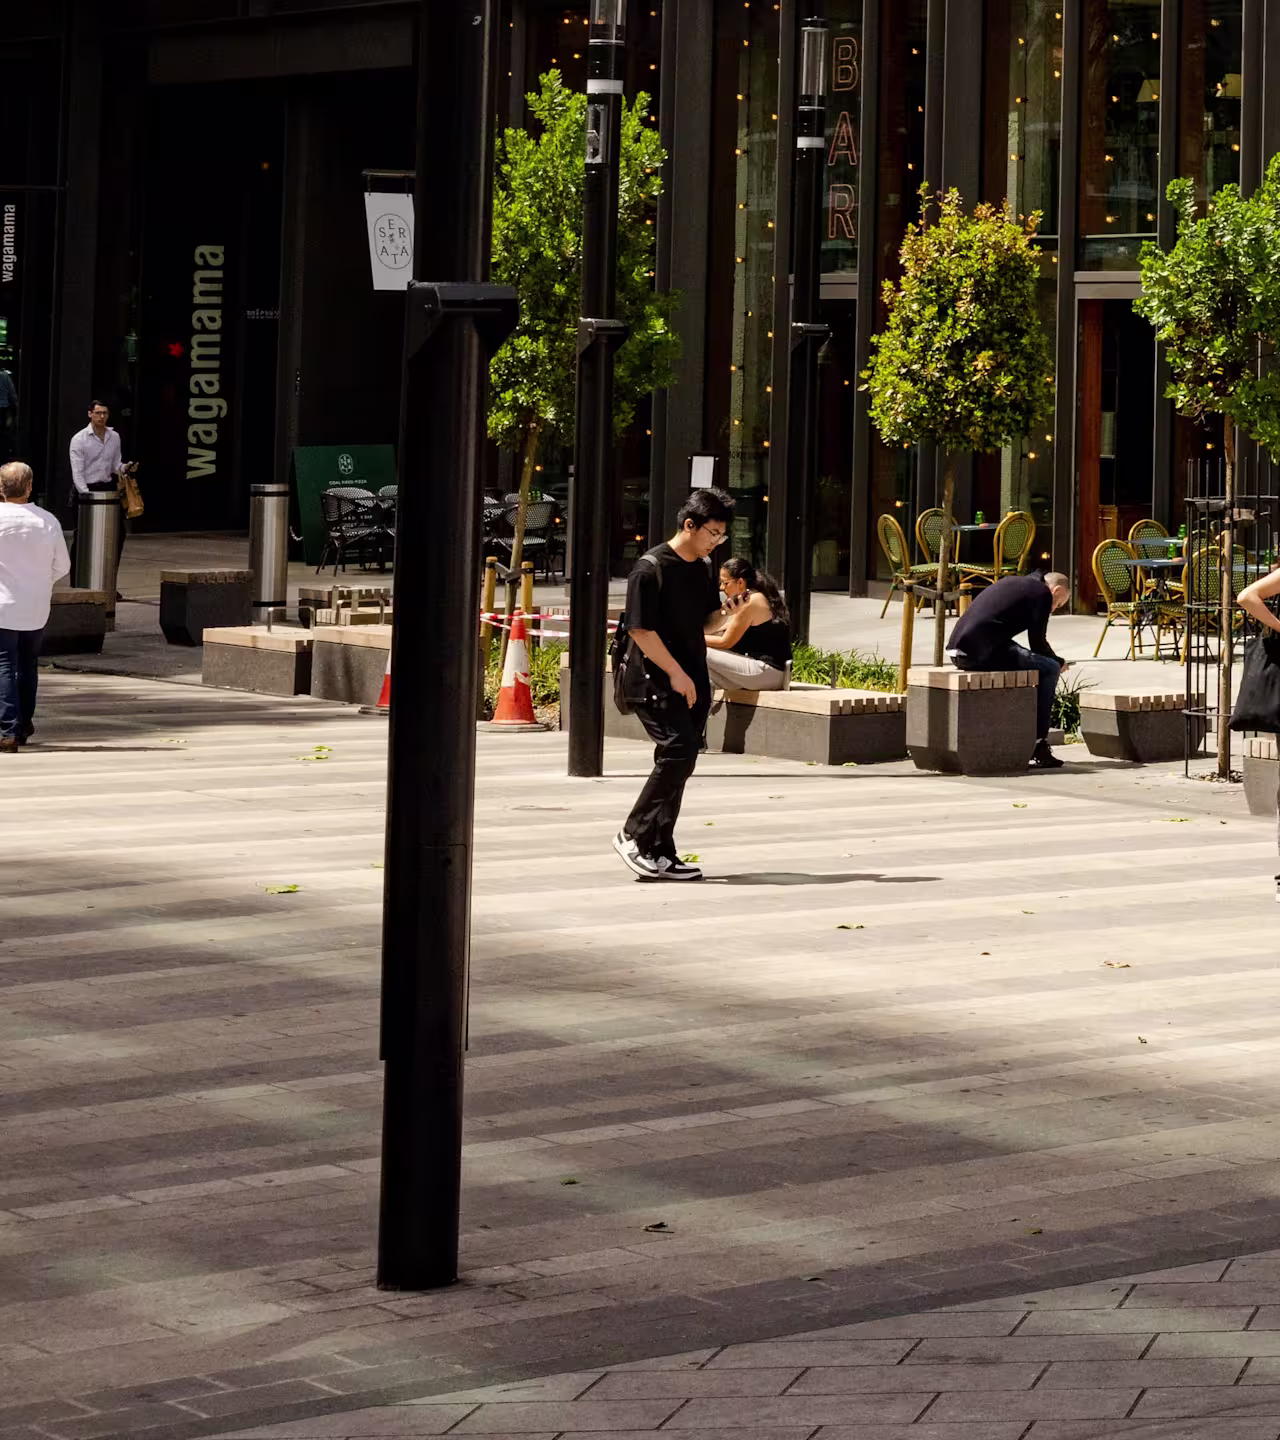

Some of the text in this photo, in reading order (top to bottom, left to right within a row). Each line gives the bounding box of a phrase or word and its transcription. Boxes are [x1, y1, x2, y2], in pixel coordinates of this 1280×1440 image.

[828, 37, 858, 239] BAR
[1, 203, 17, 282] wagamama
[186, 244, 228, 480] wagamama
